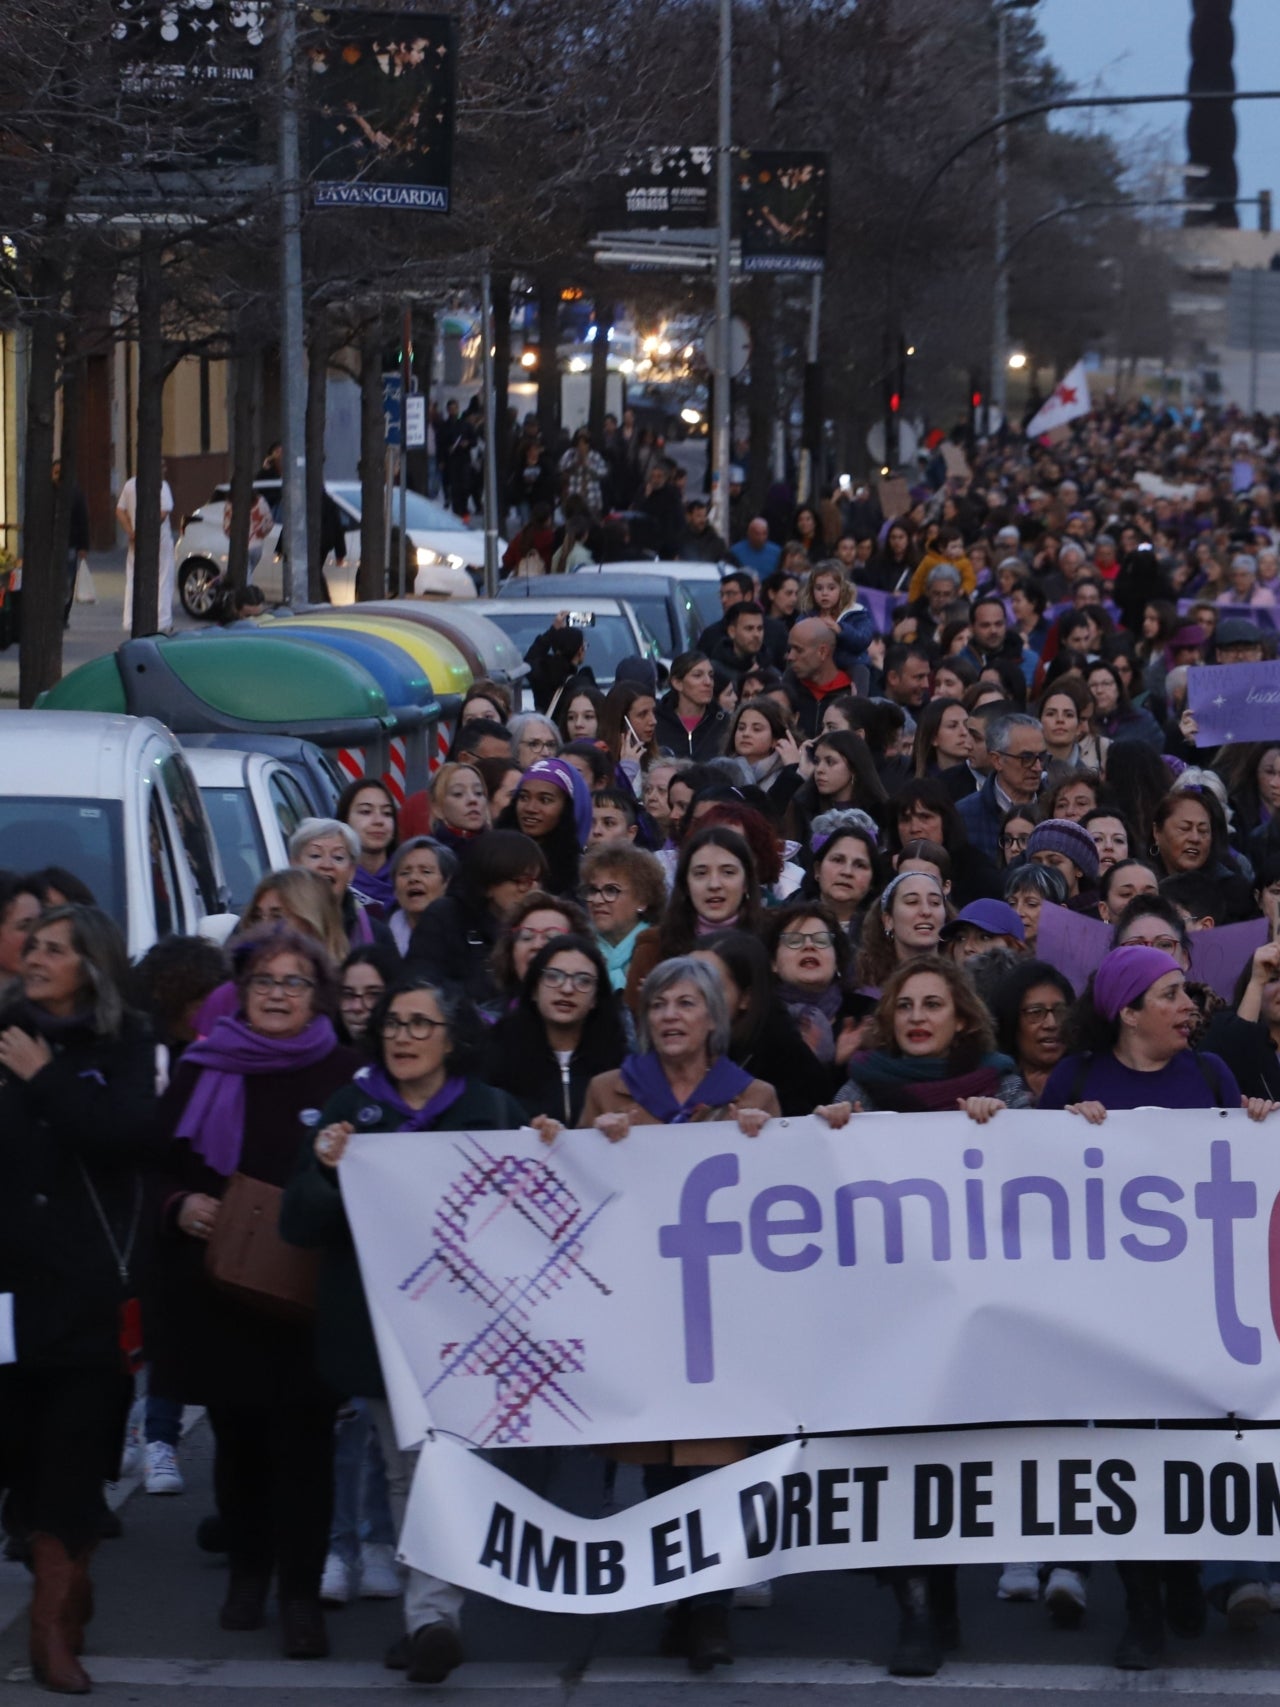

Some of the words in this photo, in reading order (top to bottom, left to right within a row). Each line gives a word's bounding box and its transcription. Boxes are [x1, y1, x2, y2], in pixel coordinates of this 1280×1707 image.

[340, 186, 445, 207] VANGUARDIA
[480, 1502, 625, 1597] AMB
[651, 1509, 721, 1587] EL
[738, 1465, 889, 1561] DRET
[913, 1461, 995, 1540] DE
[1020, 1458, 1138, 1537] LES
